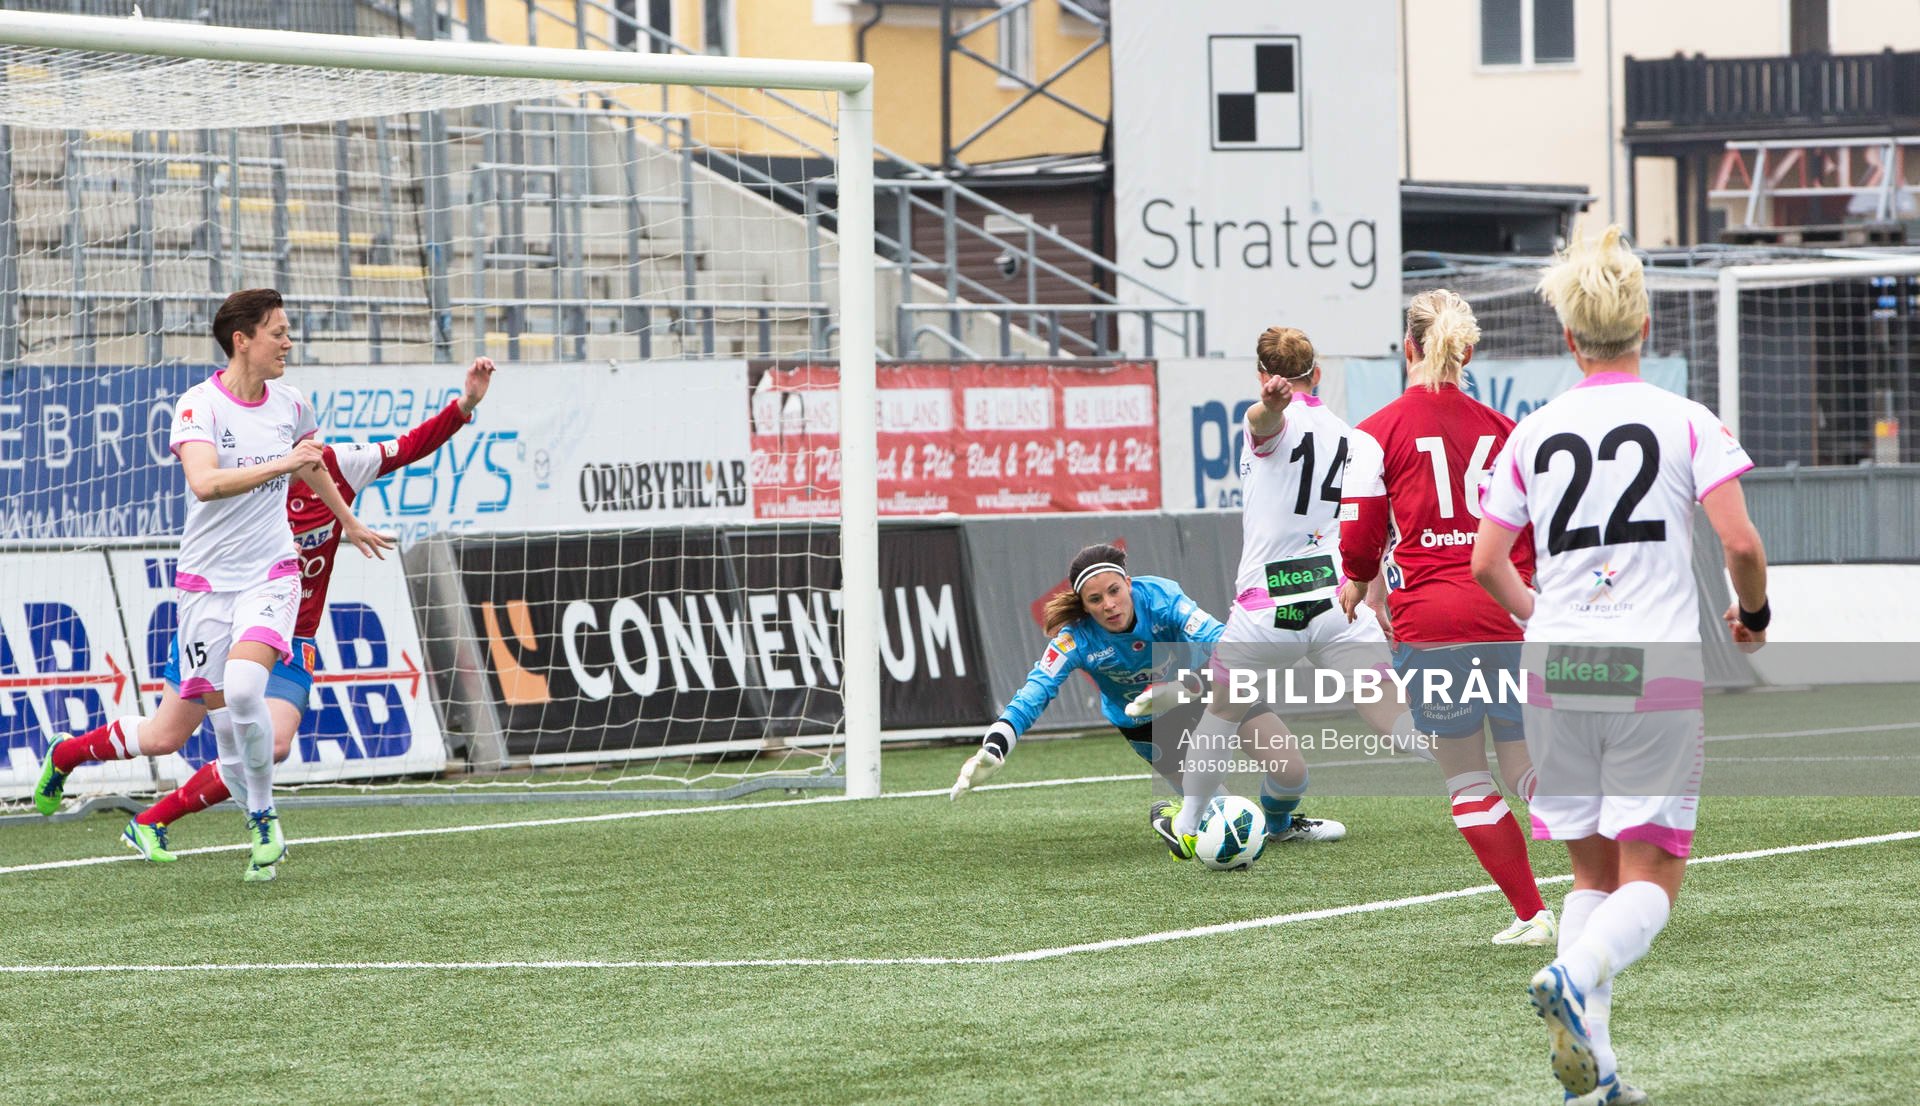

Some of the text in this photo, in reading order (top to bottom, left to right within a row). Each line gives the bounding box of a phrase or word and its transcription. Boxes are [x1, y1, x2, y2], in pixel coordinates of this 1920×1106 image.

[1142, 198, 1378, 290] Strateg
[1290, 432, 1349, 519] 14
[1415, 435, 1497, 519] 16
[1534, 423, 1667, 556] 22
[1268, 567, 1314, 588] akea
[1420, 528, 1480, 547] Örebr
[185, 642, 208, 669] 15
[562, 583, 966, 700] CONVENUM
[1546, 657, 1610, 682] akea
